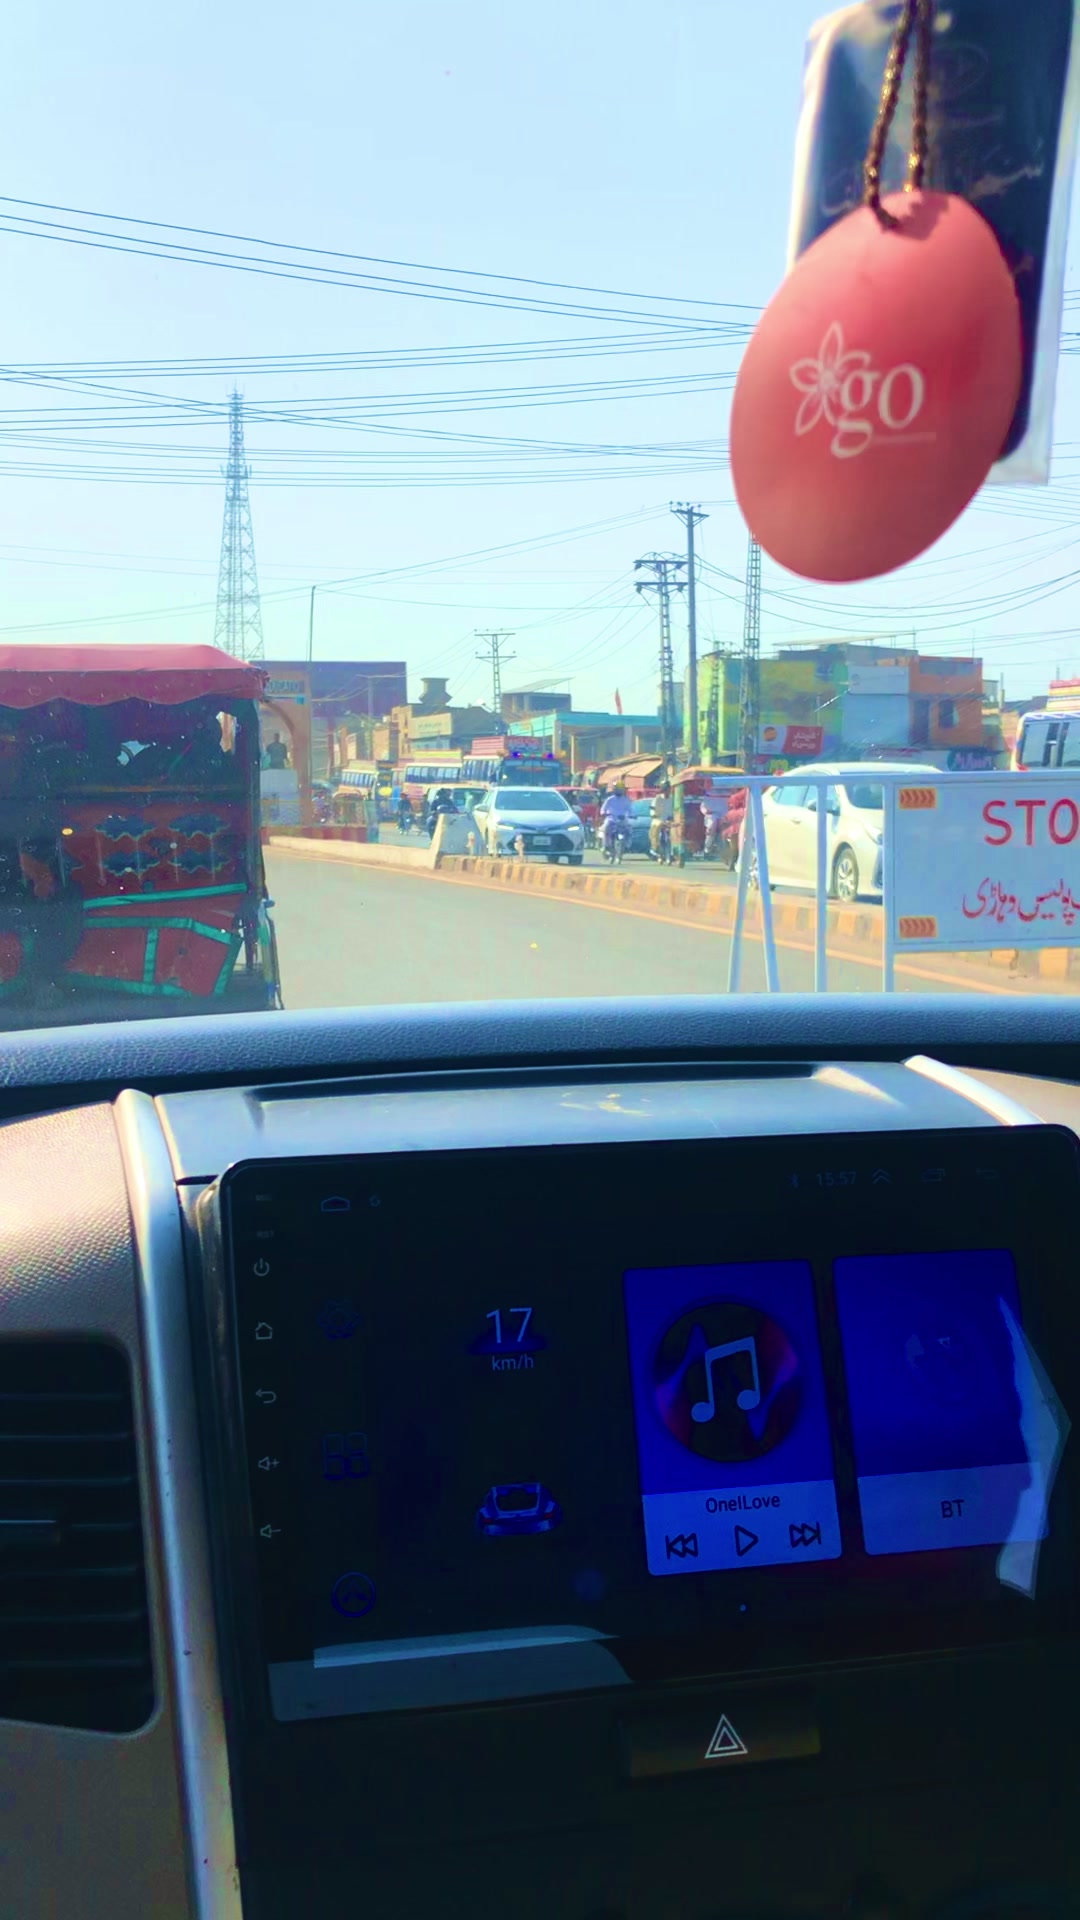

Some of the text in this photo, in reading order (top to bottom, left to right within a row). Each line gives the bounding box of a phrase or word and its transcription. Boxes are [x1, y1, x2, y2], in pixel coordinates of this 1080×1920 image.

[831, 362, 924, 458] go
[982, 797, 1079, 846] STO
[816, 1170, 857, 1187] 15:57
[486, 1307, 532, 1344] 17
[492, 1352, 534, 1371] km/h
[941, 1499, 965, 1518] BT
